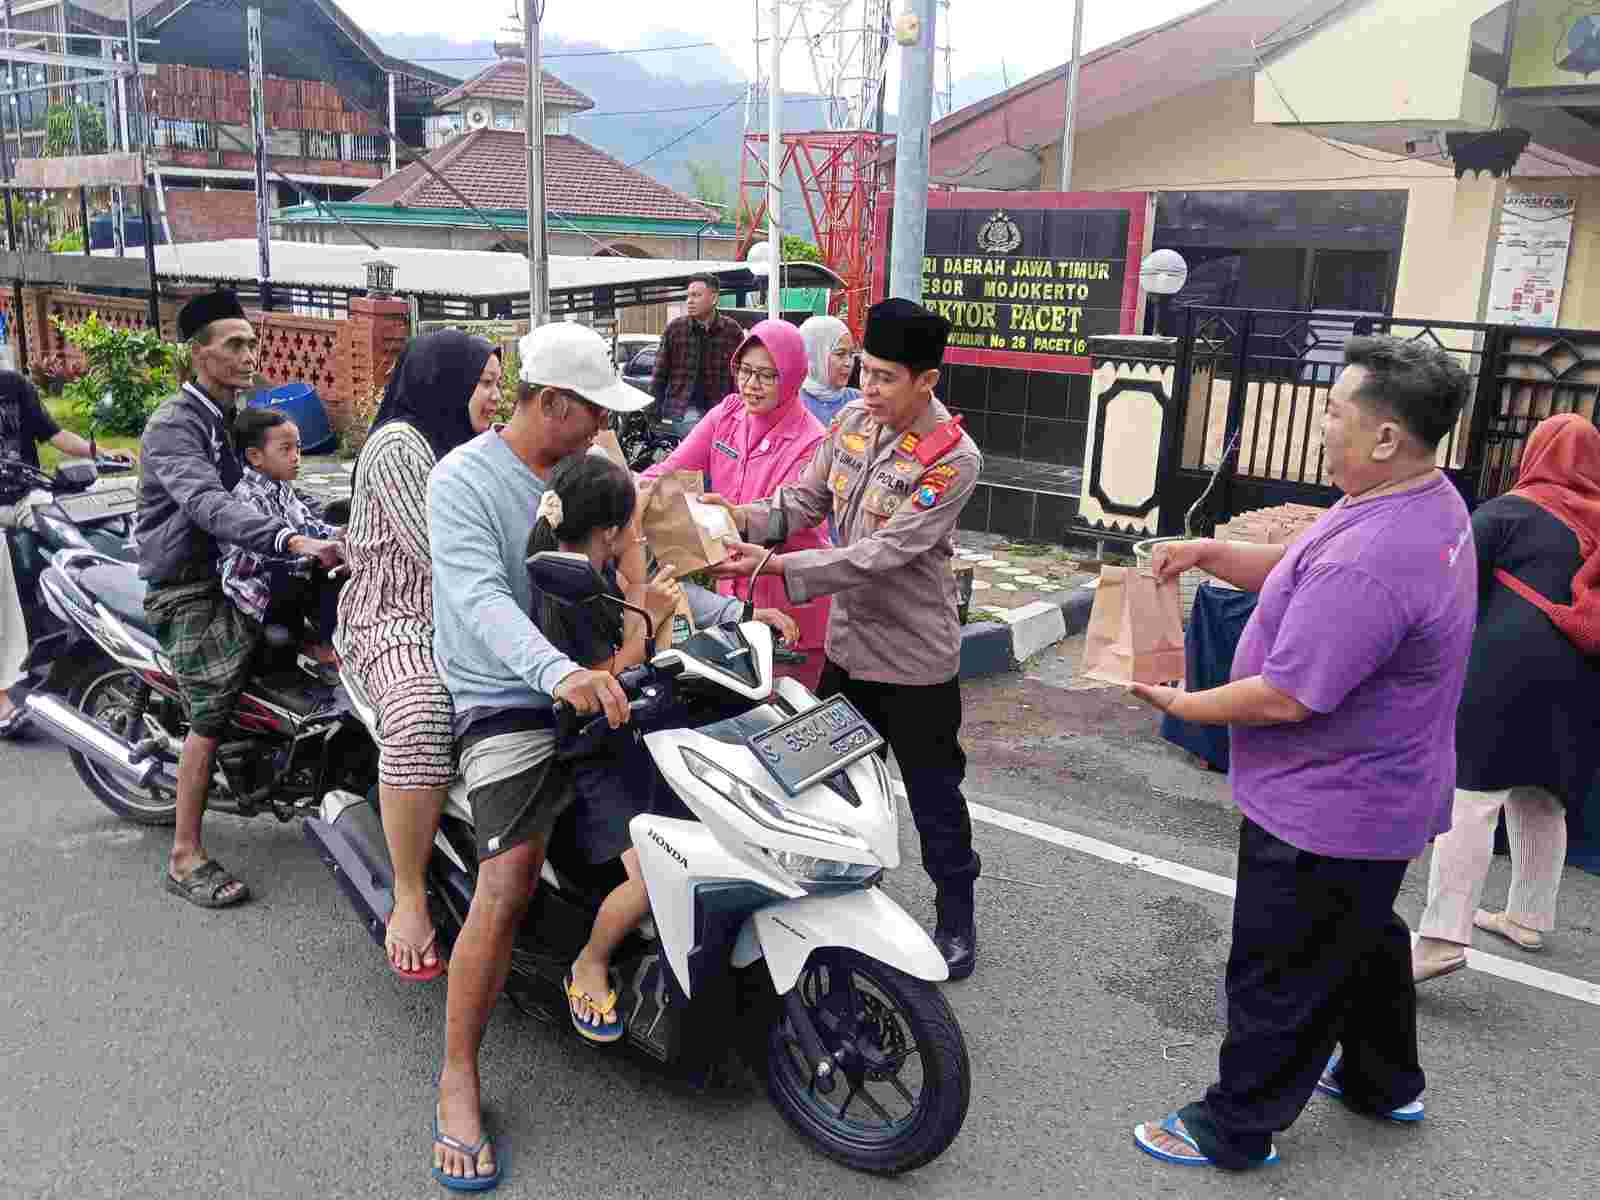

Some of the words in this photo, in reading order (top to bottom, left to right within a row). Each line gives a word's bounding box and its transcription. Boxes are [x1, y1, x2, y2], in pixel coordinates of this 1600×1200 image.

[943, 257, 1006, 276] DAERAH
[1011, 260, 1053, 278] JAWA
[1057, 261, 1110, 280] TIMUR
[983, 280, 1088, 300] MOJOKERTO
[1009, 303, 1083, 333] PACET
[990, 333, 1006, 348] No
[1011, 336, 1026, 349] 26
[1033, 336, 1072, 352] PACET
[878, 471, 911, 497] POLRI
[647, 827, 688, 869] HONDA
